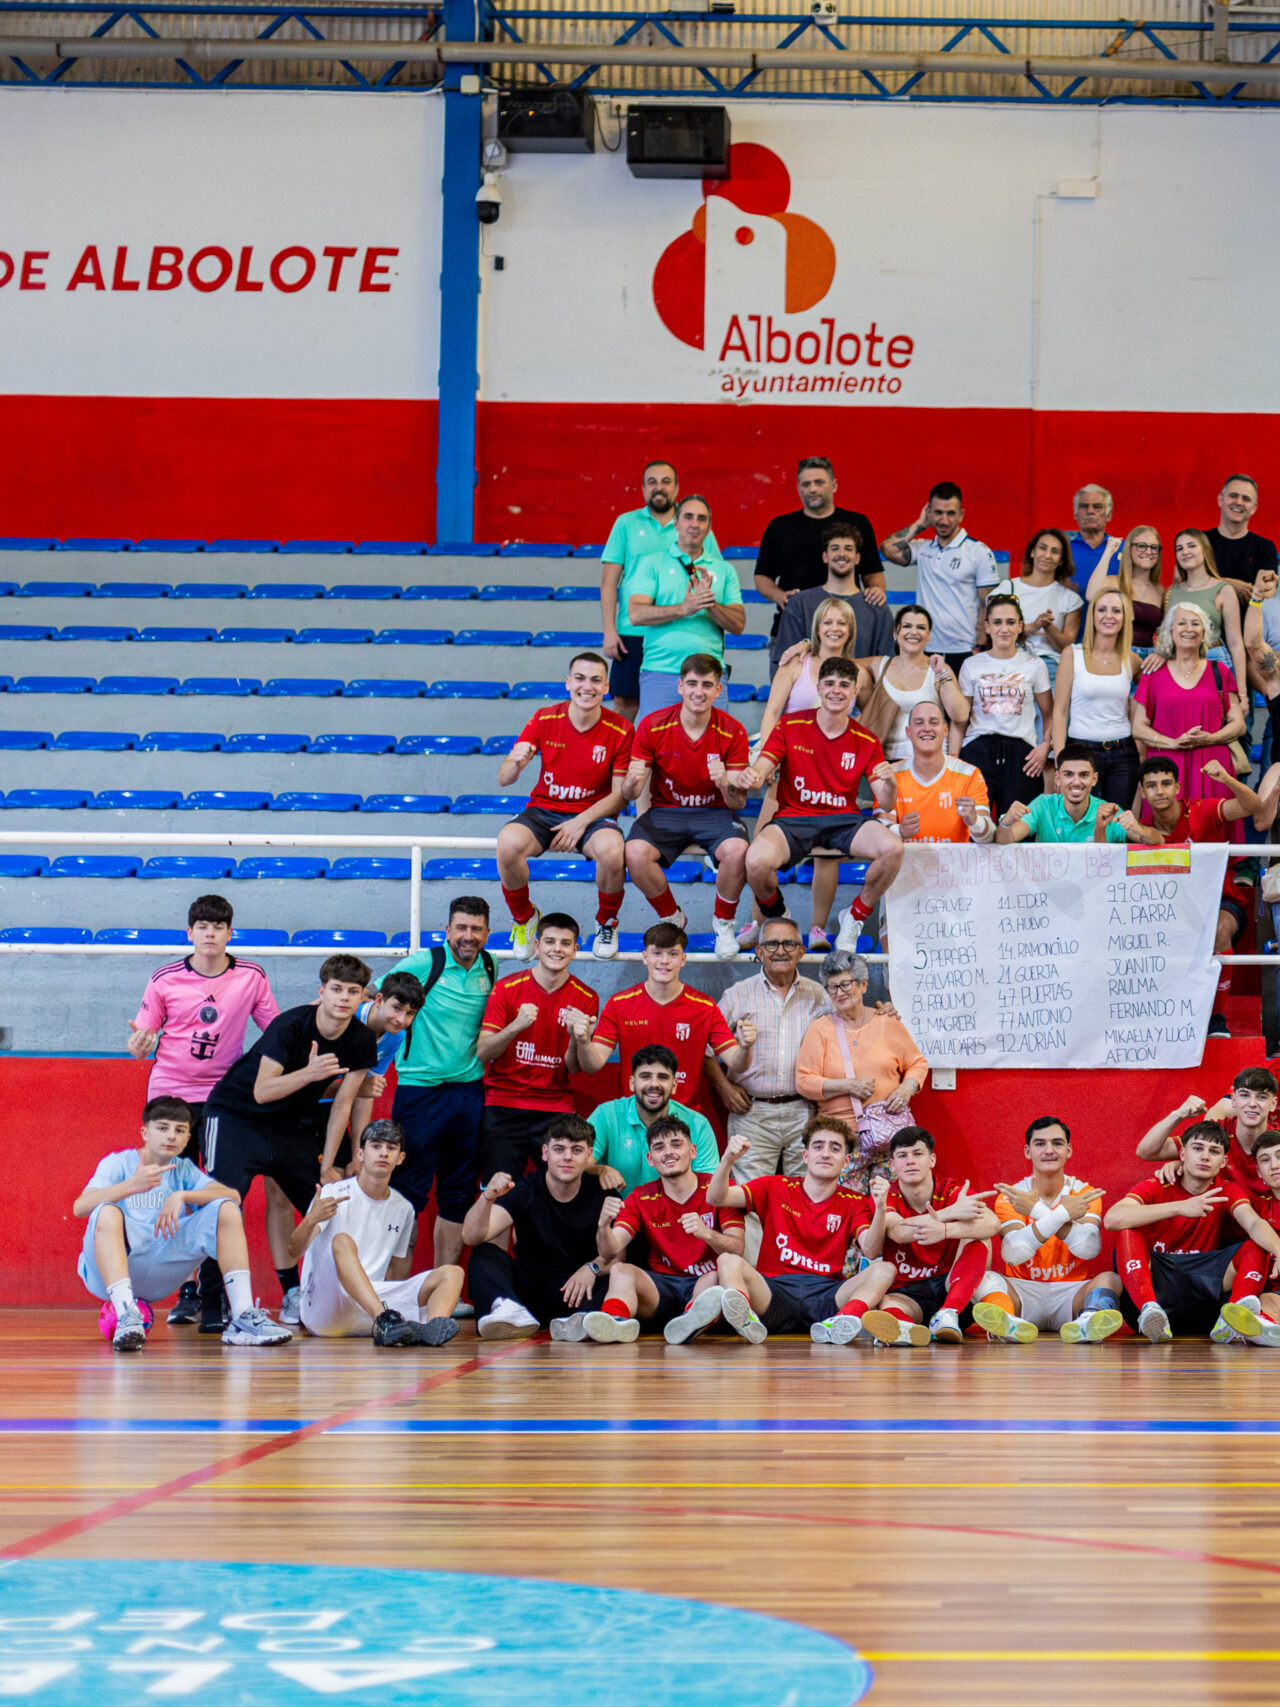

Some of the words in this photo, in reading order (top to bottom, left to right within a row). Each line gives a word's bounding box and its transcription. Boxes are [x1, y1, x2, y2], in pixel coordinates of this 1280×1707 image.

[65, 245, 400, 293] ALBOLOTE
[718, 314, 914, 368] Albolote
[720, 371, 902, 397] ayuntamiento
[800, 789, 847, 807] pyltin
[912, 846, 1070, 889] CAMPEONATO
[1086, 845, 1113, 879] DE
[1108, 907, 1126, 925] A.
[1131, 903, 1177, 924] PARRA
[1108, 933, 1152, 951] MIGUEL
[1157, 932, 1171, 947] R.
[975, 968, 989, 985] M.
[1107, 956, 1165, 976] JUANITO
[1108, 977, 1158, 996] RAULMA
[1110, 998, 1175, 1019] FERNANDO
[1180, 998, 1196, 1016] M.
[1105, 1028, 1153, 1044] MIKAELA
[1154, 1027, 1163, 1041] Y
[1165, 1022, 1196, 1042] LUCÍA
[1105, 1044, 1157, 1064] AFICIÓN
[780, 1247, 830, 1273] pyltin
